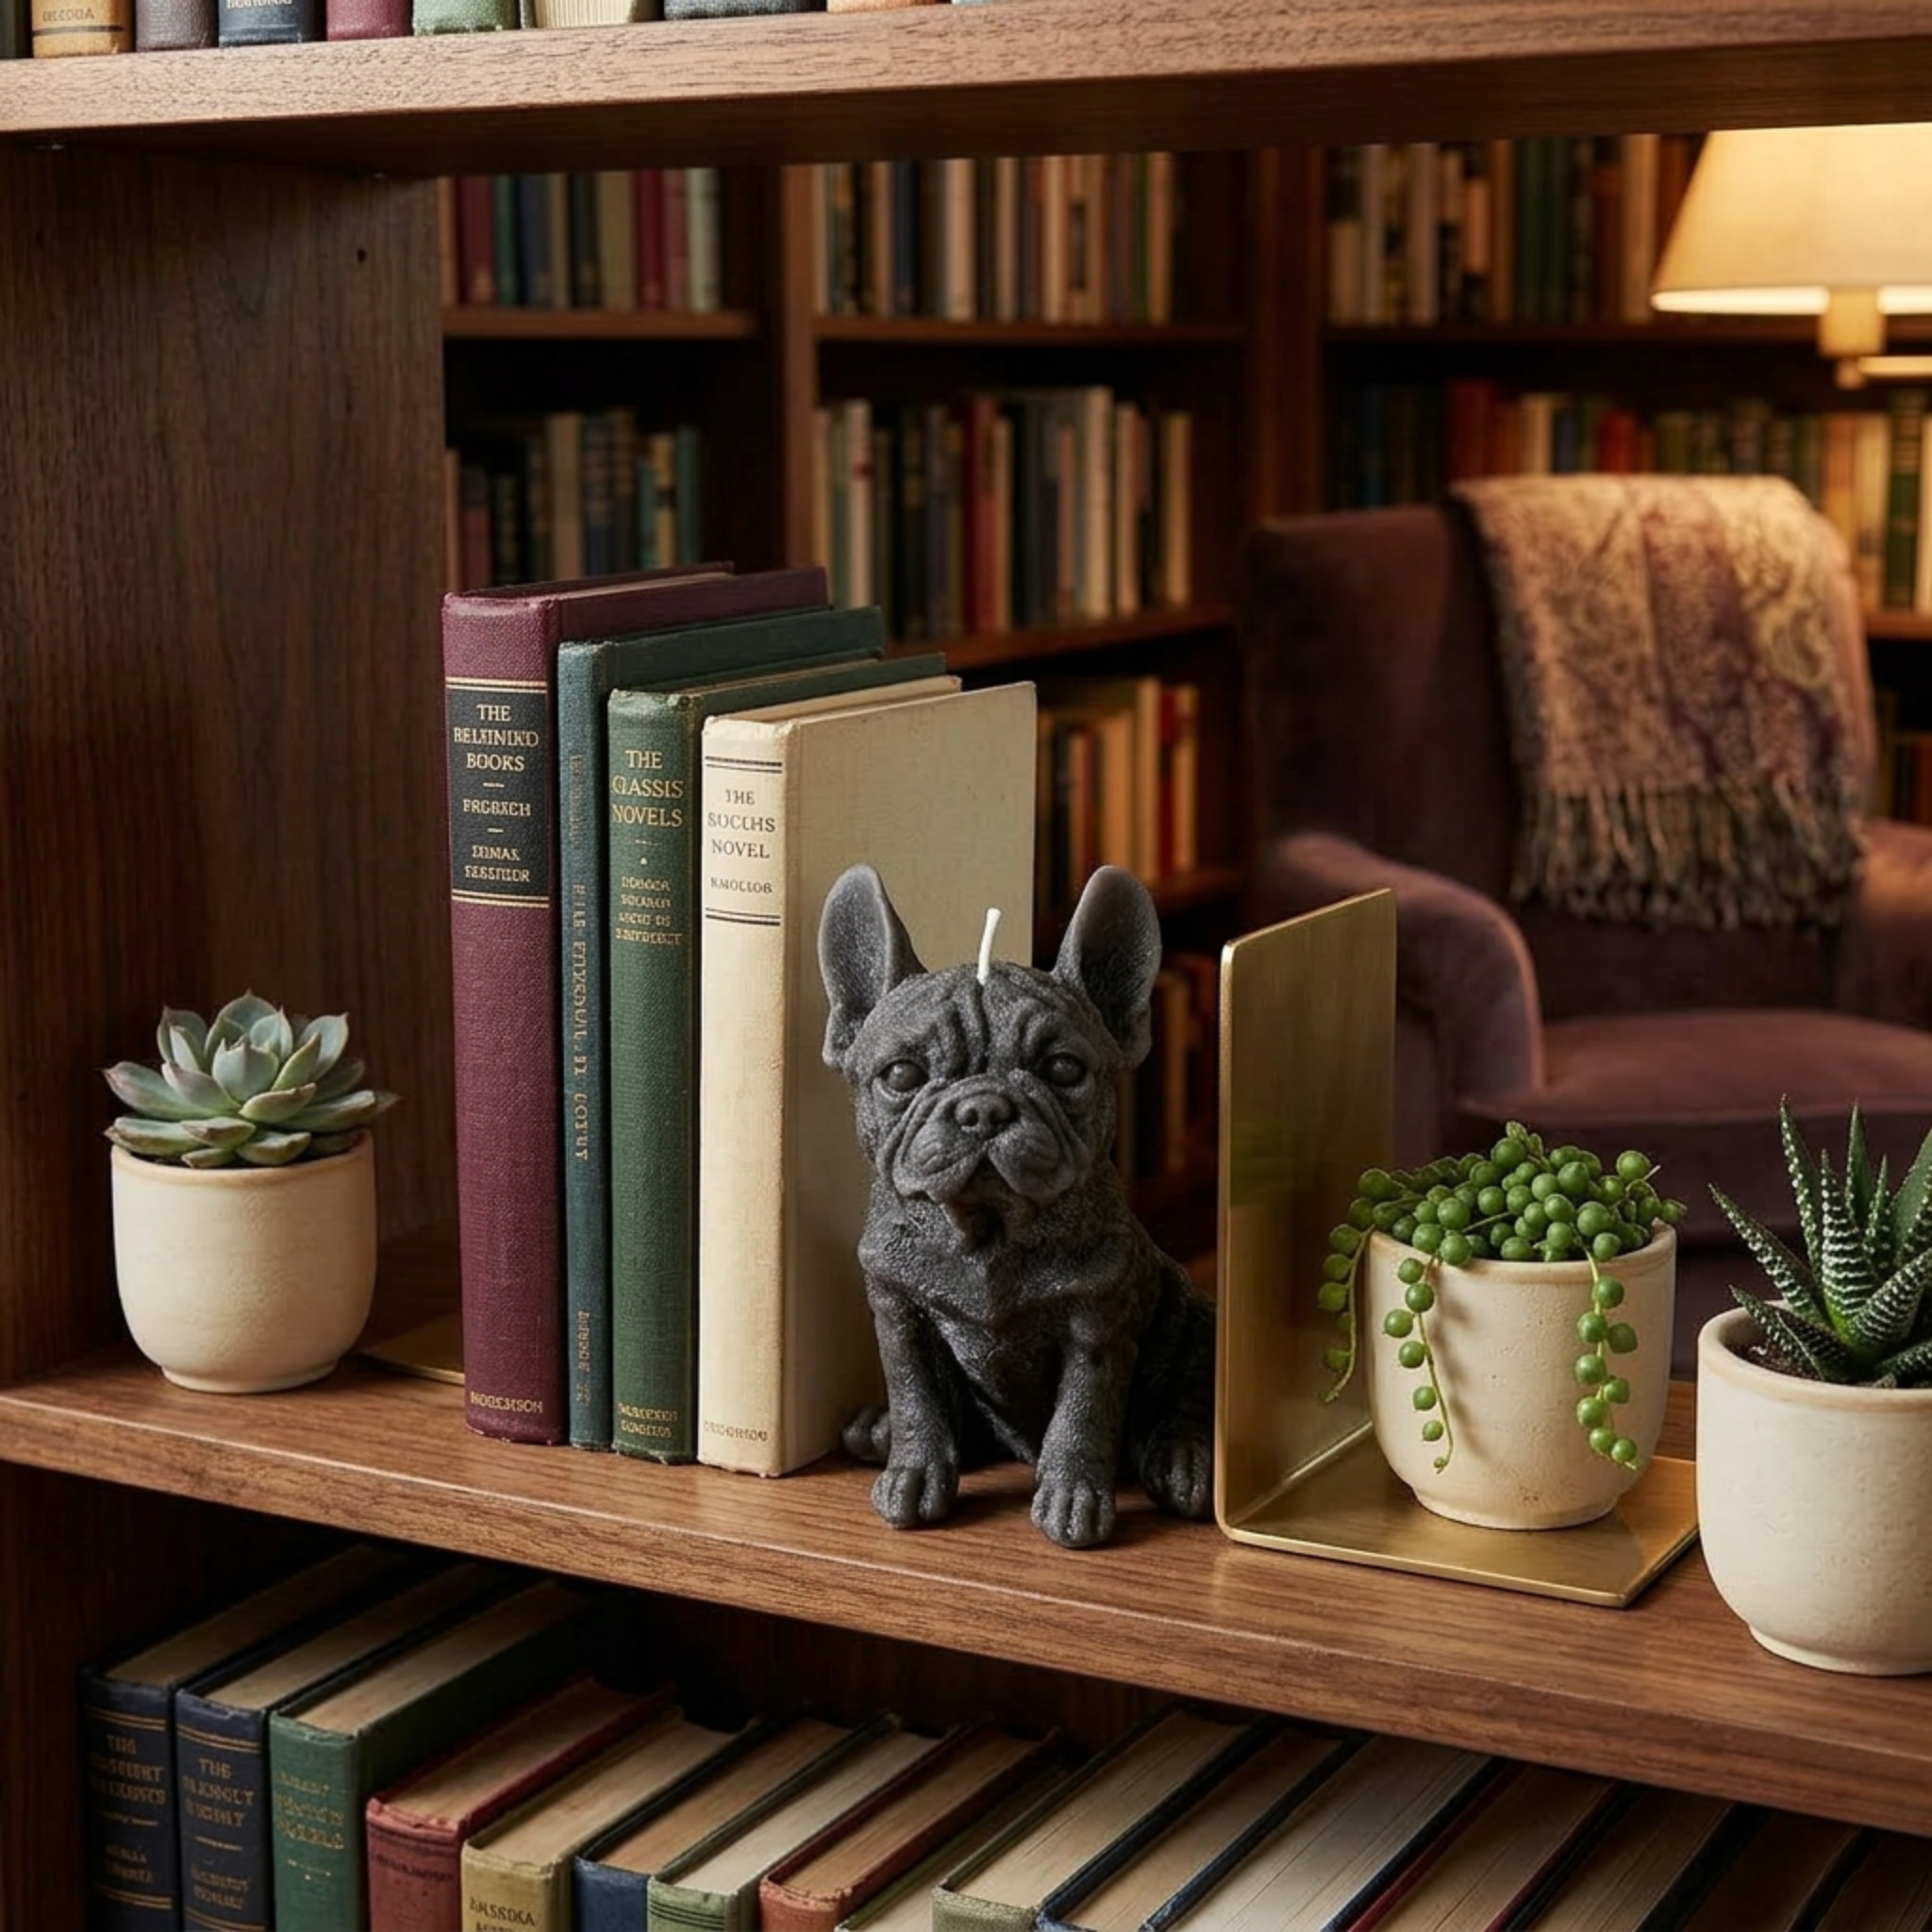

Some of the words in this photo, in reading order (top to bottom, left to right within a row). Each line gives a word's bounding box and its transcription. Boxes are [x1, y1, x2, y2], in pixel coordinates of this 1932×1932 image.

[476, 704, 511, 722] THE
[466, 752, 525, 772] BOOKS
[625, 749, 663, 769] THE
[724, 789, 755, 806] THE
[613, 804, 683, 827] NOVELS
[711, 839, 771, 859] NOVEL
